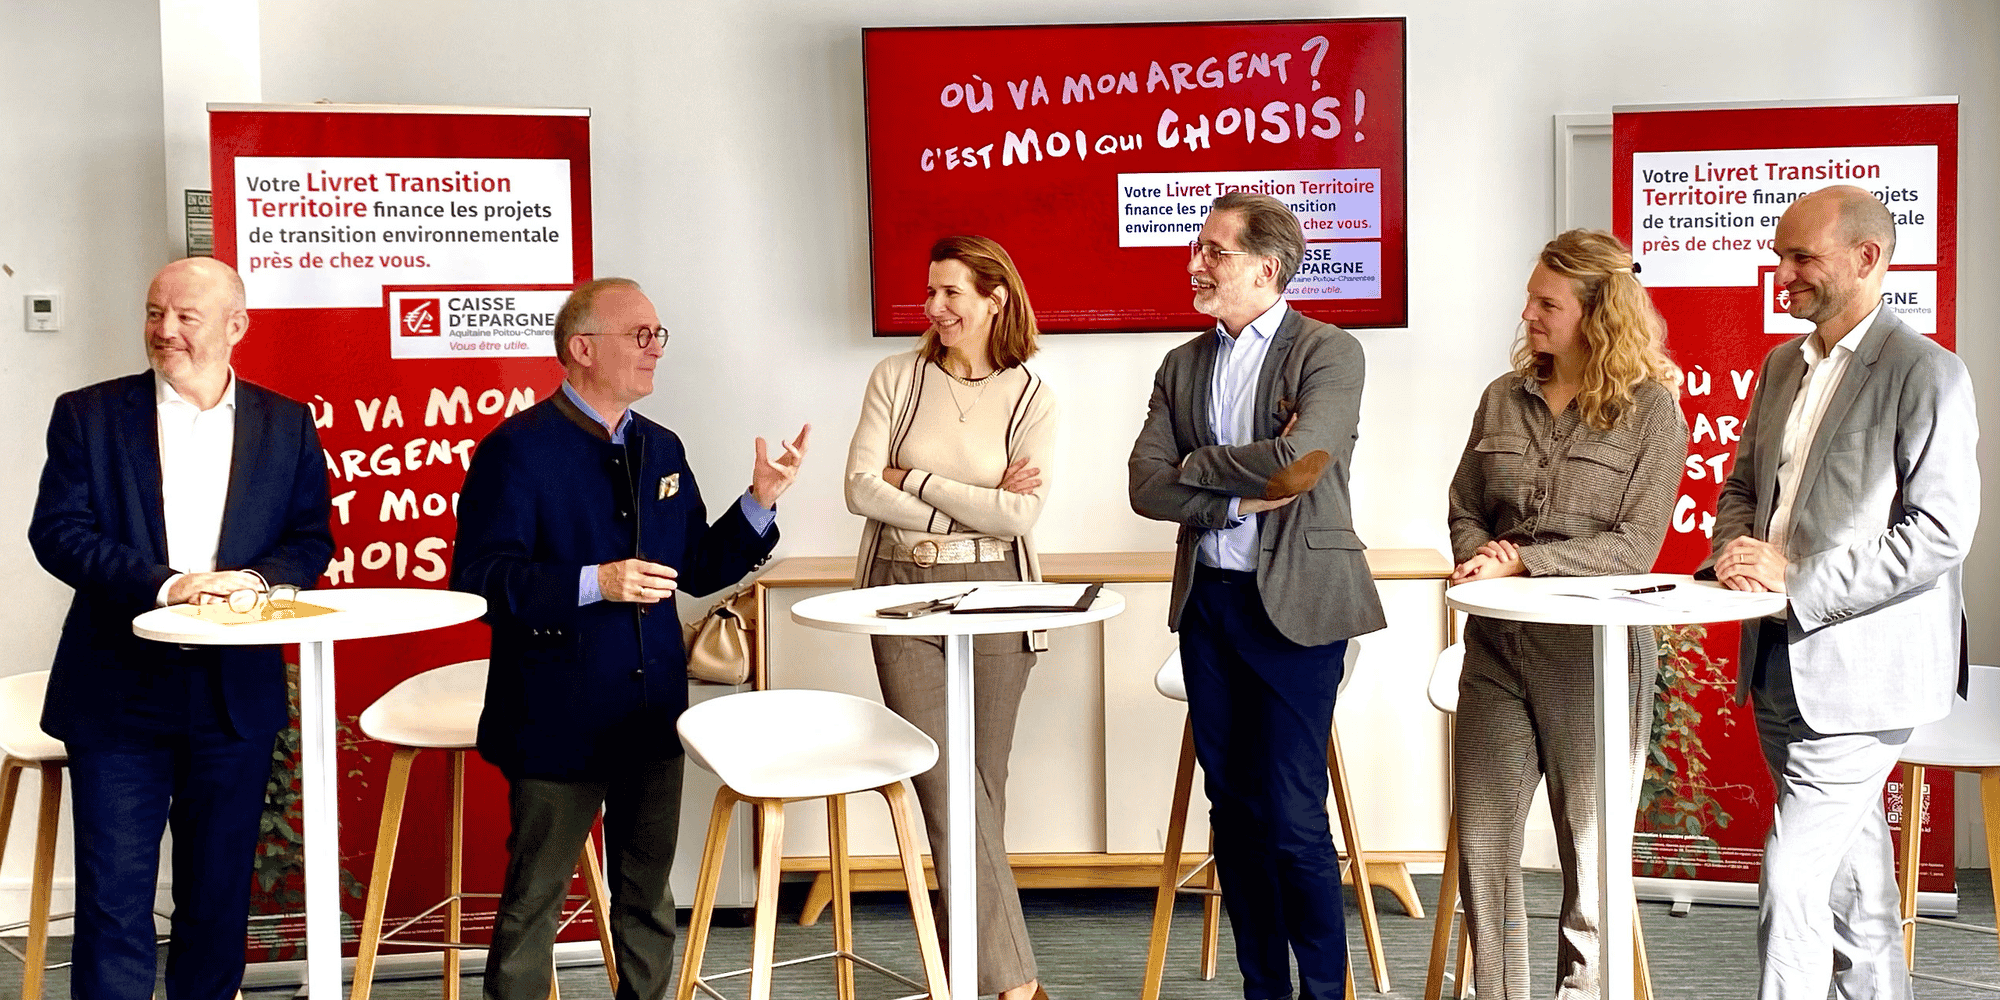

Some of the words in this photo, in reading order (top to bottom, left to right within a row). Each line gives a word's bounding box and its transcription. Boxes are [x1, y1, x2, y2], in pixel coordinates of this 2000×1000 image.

[940, 74, 994, 113] OÙ
[1007, 75, 1049, 110] VA
[1062, 71, 1138, 104] MON
[1146, 51, 1292, 94] ARGENT
[921, 144, 994, 172] C'EST
[1002, 128, 1088, 166] MOI
[1094, 134, 1143, 154] QUI
[1157, 96, 1342, 152] CHOISIS
[1642, 169, 1689, 183] Votre
[1694, 162, 1759, 182] Livret
[1765, 158, 1881, 181] Transition
[246, 176, 301, 192] Votre
[306, 170, 379, 192] Livret
[385, 170, 511, 193] Transition
[1124, 186, 1161, 198] Votre
[1166, 181, 1212, 197] Livret
[1300, 177, 1375, 195] Territoire
[1642, 185, 1747, 206] Territoire
[1753, 189, 1807, 204] finan
[1871, 186, 1919, 206] ojets
[247, 195, 367, 218] Territoire
[373, 201, 445, 218] finance
[450, 201, 478, 218] les
[484, 200, 552, 221] projets
[1125, 203, 1174, 215] finance
[1177, 202, 1196, 215] les
[1285, 199, 1337, 213] nsition
[1125, 219, 1204, 233] environnem
[1303, 217, 1334, 229] chez
[1337, 219, 1372, 229] vous.
[1642, 214, 1664, 229] de
[1668, 212, 1754, 228] transition
[248, 226, 273, 243] de
[279, 225, 376, 243] transition
[382, 225, 560, 243] environnementale
[1642, 235, 1680, 255] près
[1685, 236, 1707, 251] de
[1712, 235, 1752, 250] chez
[250, 251, 293, 273] près
[299, 251, 323, 268] de
[330, 251, 375, 268] chez
[379, 255, 431, 268] vous.
[1304, 248, 1332, 261] SSE
[1297, 261, 1364, 275] PARGNE
[1284, 287, 1300, 295] ous
[448, 297, 516, 311] CAISSE
[449, 313, 555, 327] D'EPARGNE
[449, 329, 492, 339] Aquitaine
[493, 328, 554, 337] Poitou-Charen
[449, 341, 477, 351] Vous
[479, 340, 502, 351] être
[503, 340, 530, 350] utile.
[1687, 364, 1711, 397] Ù
[1730, 368, 1759, 400] V
[308, 394, 334, 428] Ù
[354, 394, 404, 432] VA
[424, 386, 536, 427] MON
[323, 536, 449, 586] HOIS
